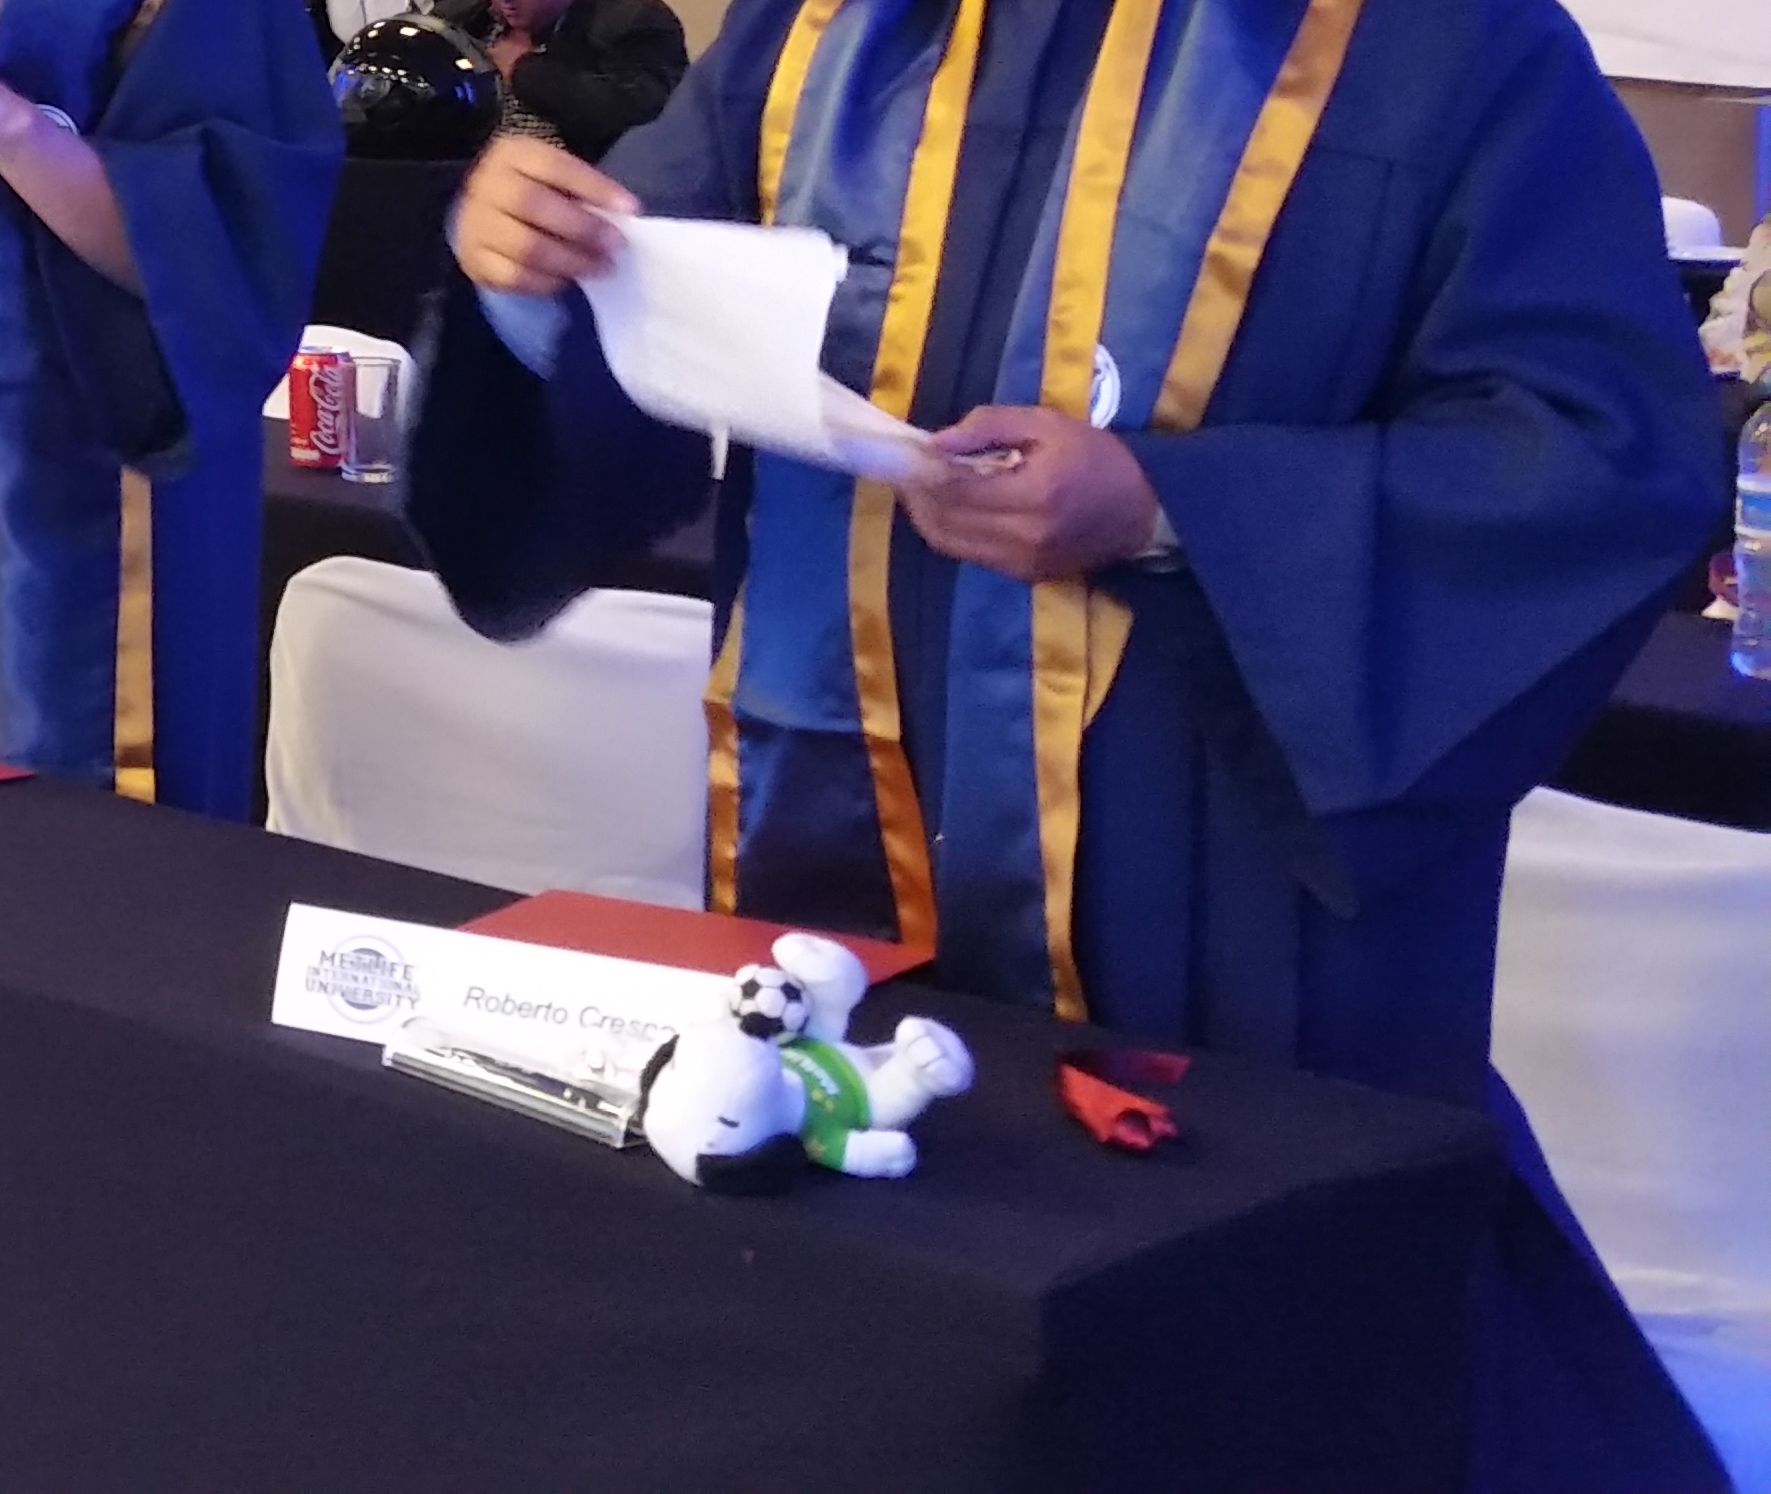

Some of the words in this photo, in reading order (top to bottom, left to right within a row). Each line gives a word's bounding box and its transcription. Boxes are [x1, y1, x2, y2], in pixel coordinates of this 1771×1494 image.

[318, 949, 416, 981] METLIFE
[305, 977, 420, 1010] UNIVERSITY
[463, 985, 569, 1025] Roberto
